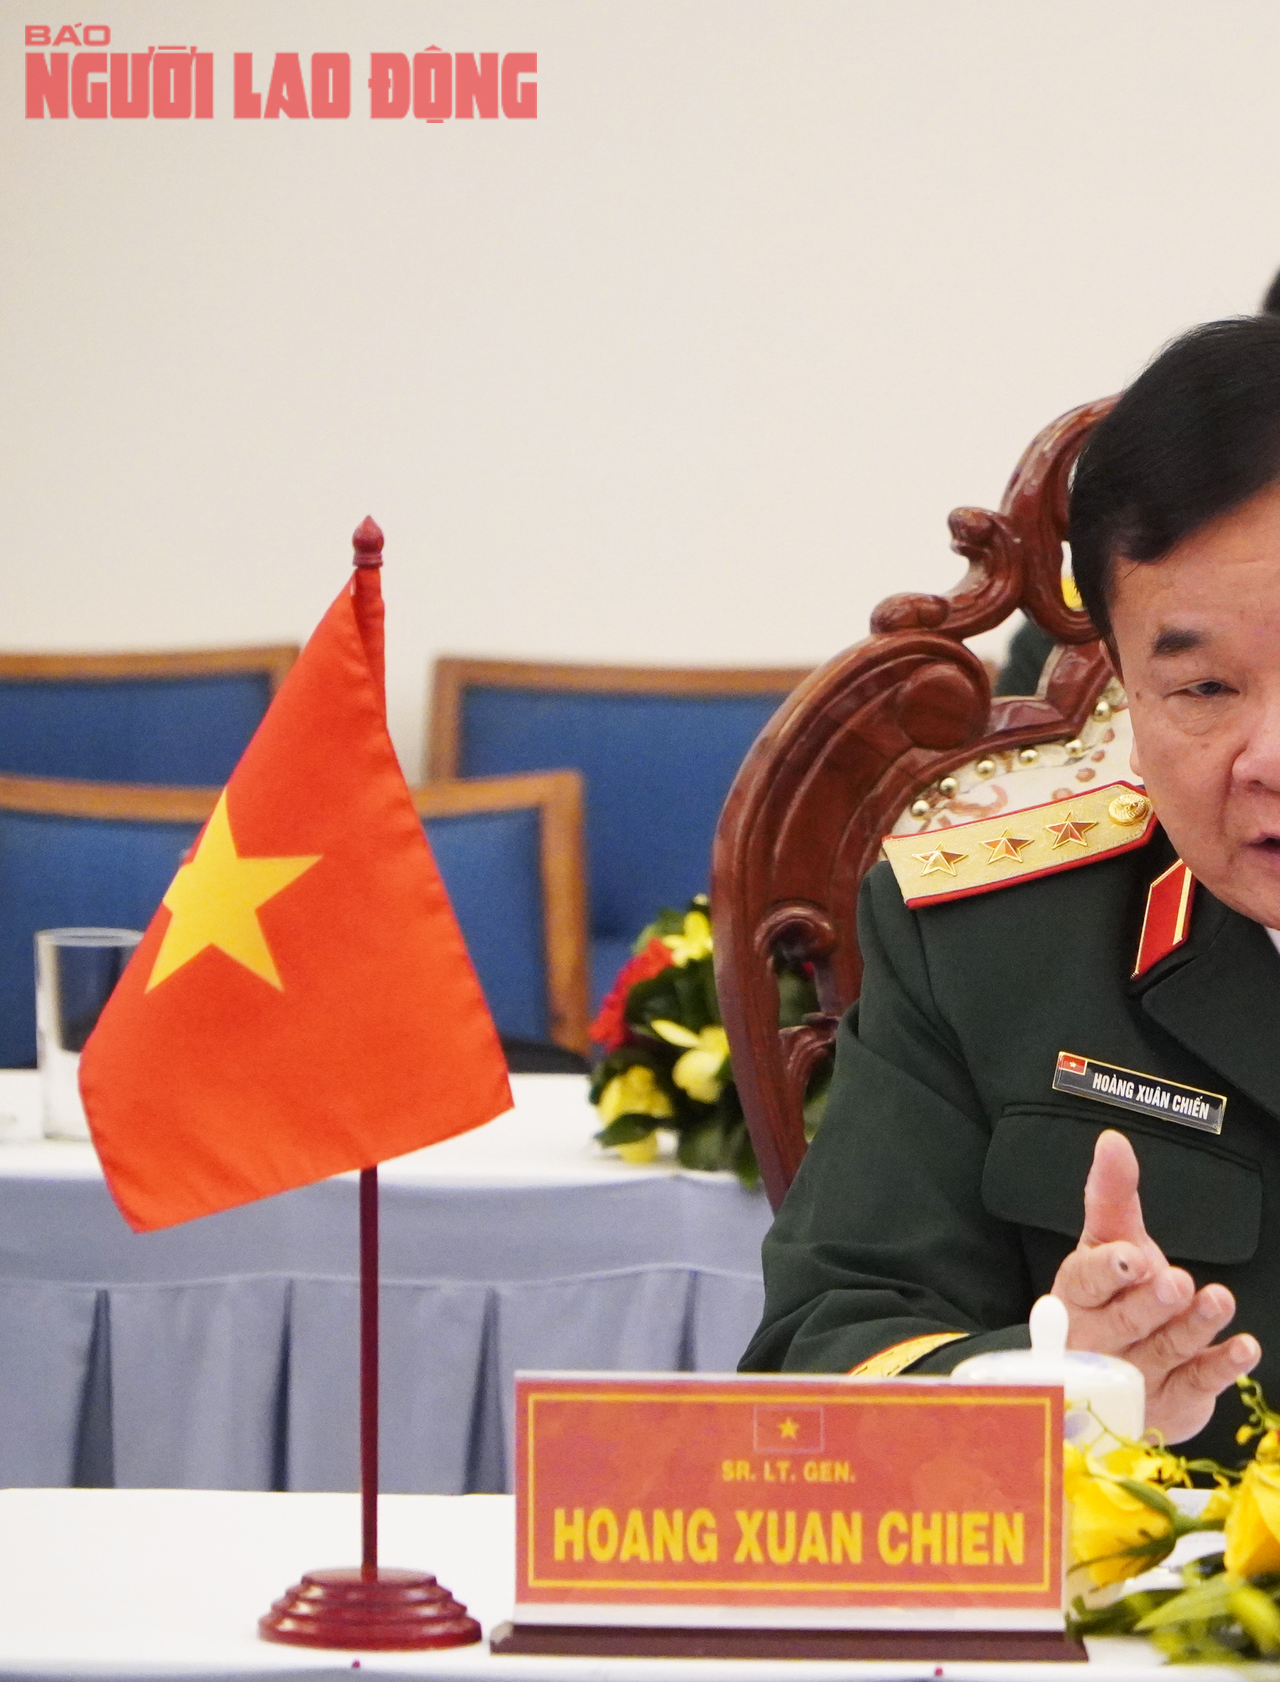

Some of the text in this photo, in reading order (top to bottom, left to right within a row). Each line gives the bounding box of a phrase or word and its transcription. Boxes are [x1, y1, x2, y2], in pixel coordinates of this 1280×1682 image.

[1092, 1073, 1209, 1121] HOÀNG XUÂN CHIẾN
[721, 1459, 856, 1484] SR. LT. GEN.
[553, 1507, 1026, 1567] HOANG XUAN CHIEN
